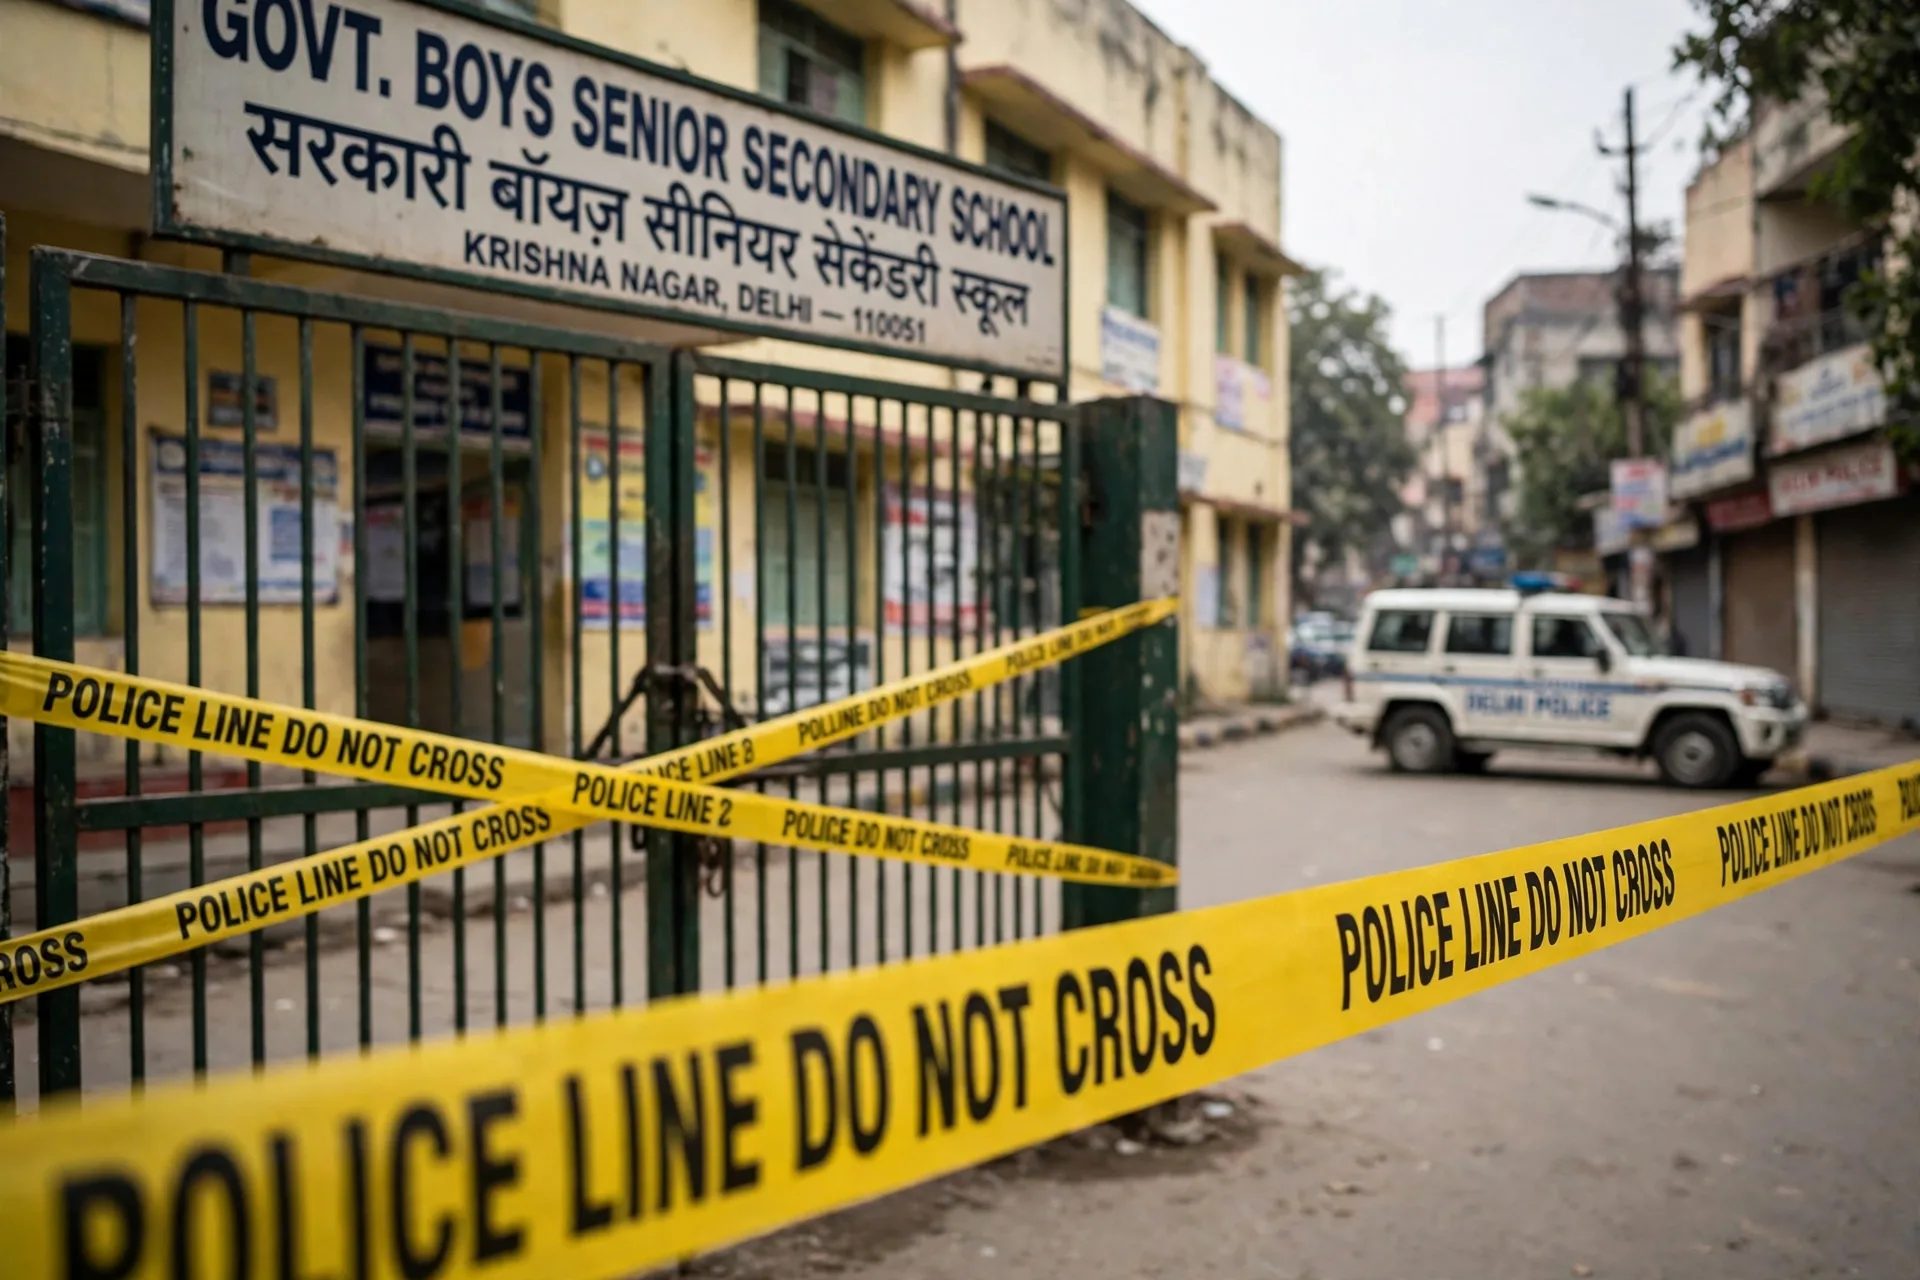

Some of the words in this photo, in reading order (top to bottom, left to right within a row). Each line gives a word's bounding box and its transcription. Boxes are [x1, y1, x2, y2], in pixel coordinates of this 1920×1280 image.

[202, 0, 391, 98] GOVT.
[415, 29, 553, 138] BOYS
[572, 75, 729, 183] SENIOR
[742, 125, 942, 235] SECONDARY
[950, 187, 1055, 267] SCHOOL
[244, 101, 471, 211] सरकारी
[488, 147, 629, 246] बॉयज़
[643, 181, 800, 280] सीनियर
[813, 219, 940, 307] सेकेंडरी
[951, 267, 1030, 337] स्कूल
[465, 230, 610, 288] KRISHNA
[621, 262, 729, 313] NAGAR,
[739, 284, 813, 323] DELHI
[854, 308, 926, 344] 110051
[43, 671, 185, 734] POLICE
[194, 698, 275, 750] LINE
[282, 719, 328, 759] DO
[337, 728, 403, 772] NOT
[409, 742, 505, 791] CROSS
[868, 697, 890, 721] DO
[894, 686, 921, 713] NOT
[926, 669, 972, 701] CROSS
[573, 772, 659, 818] POLICE
[664, 786, 713, 824] LINE
[718, 798, 733, 828] 2
[696, 742, 739, 777] LINE
[175, 876, 290, 940] POLICE
[296, 859, 363, 905] LINE
[368, 844, 407, 886] DO
[413, 827, 464, 869] NOT
[472, 806, 551, 852] CROSS
[855, 820, 880, 850] DO
[883, 825, 917, 853] NOT
[921, 830, 970, 861] CROSS
[1716, 813, 1770, 888] POLICE
[1770, 806, 1801, 867] LINE
[1800, 802, 1820, 859] DO
[1820, 795, 1844, 852] NOT
[0, 931, 88, 993] ROSS
[1335, 890, 1454, 1011] POLICE
[1461, 875, 1522, 972] LINE
[1527, 865, 1561, 951] DO
[1564, 853, 1608, 938] NOT
[1612, 837, 1676, 917] CROSS
[56, 1083, 527, 1280] POLICE
[561, 1041, 762, 1239] LINE
[790, 1011, 889, 1172] DO
[910, 983, 1033, 1141] NOT
[1053, 942, 1218, 1098] CROSS
